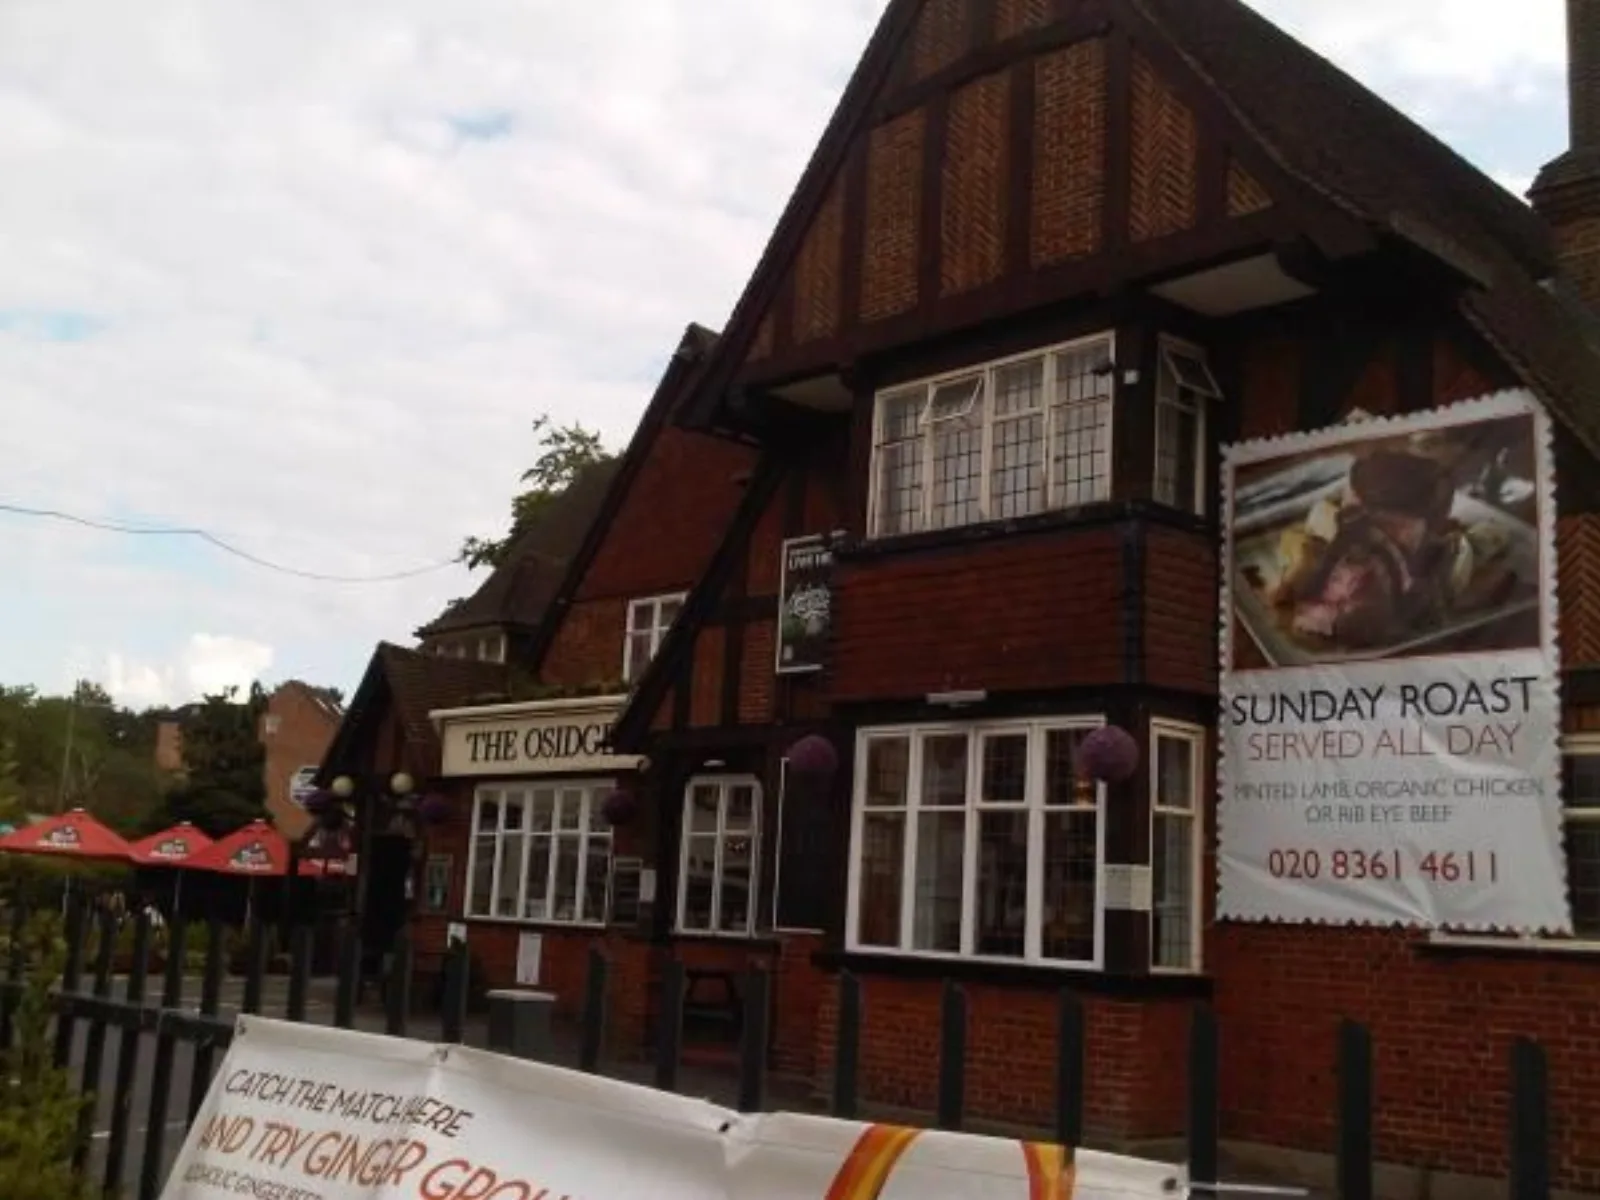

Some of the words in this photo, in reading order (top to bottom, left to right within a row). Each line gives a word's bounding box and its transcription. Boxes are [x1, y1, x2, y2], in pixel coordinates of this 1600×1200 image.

[1231, 684, 1385, 726] SUNDAY
[1399, 676, 1539, 719] ROAST
[466, 730, 518, 763] THE
[1248, 728, 1364, 762] SERVED
[1374, 726, 1435, 757] ALL
[1446, 722, 1522, 756] DAY
[1453, 776, 1545, 799] CHICKEN
[1305, 804, 1334, 824] OR
[1370, 803, 1404, 823] EYE
[1409, 804, 1452, 823] BEEF
[1267, 850, 1321, 879] 020
[1331, 850, 1402, 880] 8361
[1418, 850, 1498, 883] 4611
[225, 1068, 293, 1104] CATCH
[291, 1079, 337, 1112] THE
[249, 1122, 314, 1169] TRY
